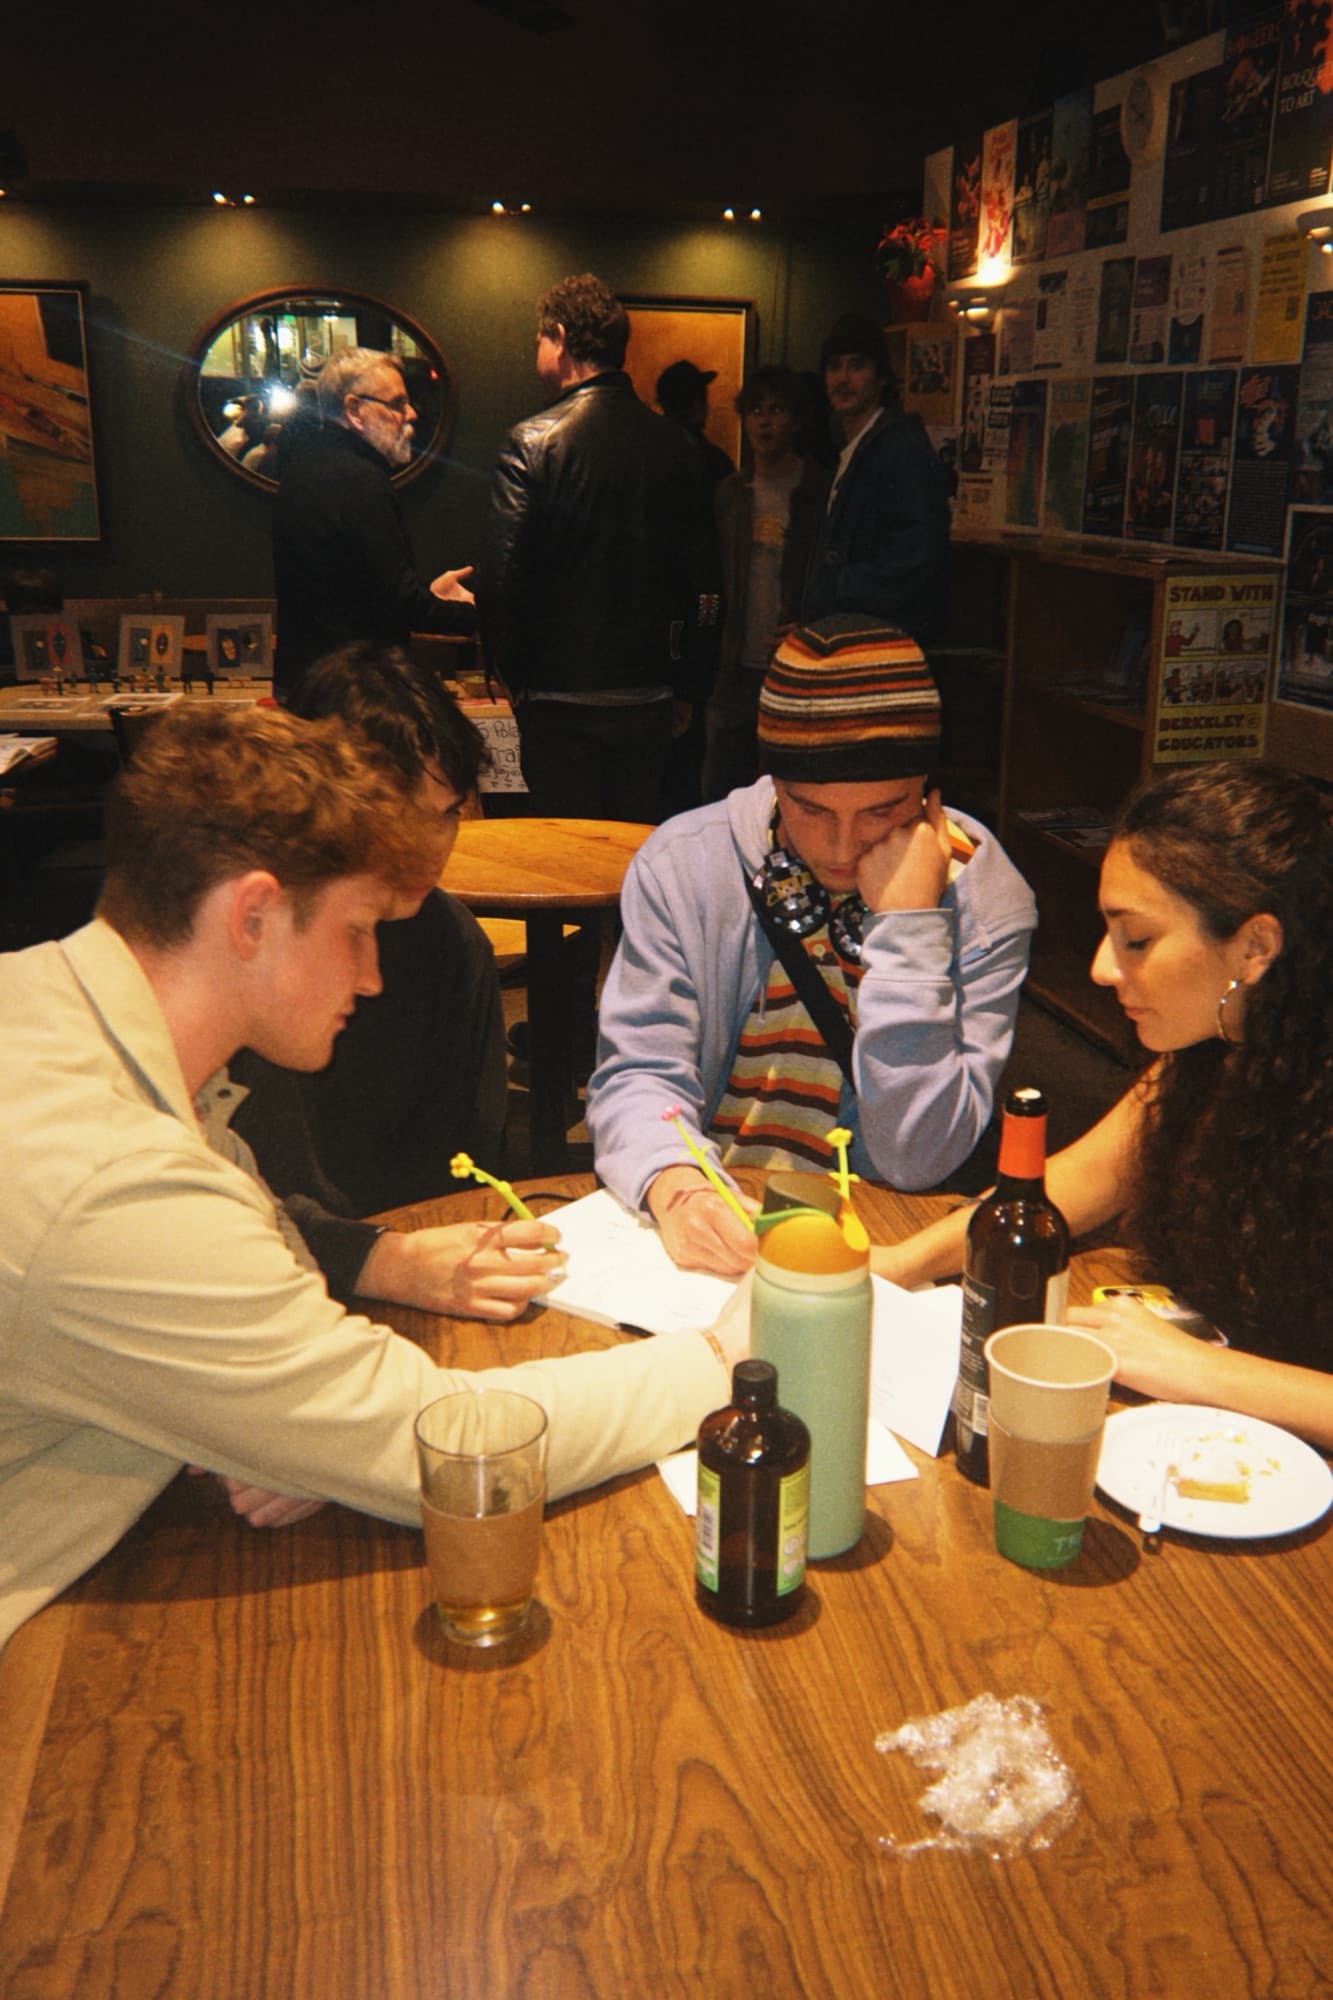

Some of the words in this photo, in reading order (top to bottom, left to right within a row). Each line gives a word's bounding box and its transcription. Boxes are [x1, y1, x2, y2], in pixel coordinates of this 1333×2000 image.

[1279, 96, 1296, 114] TO
[1295, 88, 1317, 110] ART
[1169, 585, 1226, 602] STAND
[1230, 584, 1274, 601] WITH
[493, 720, 520, 738] Pola
[1159, 714, 1244, 732] BERKELEY
[1157, 735, 1258, 751] EDUCATORS
